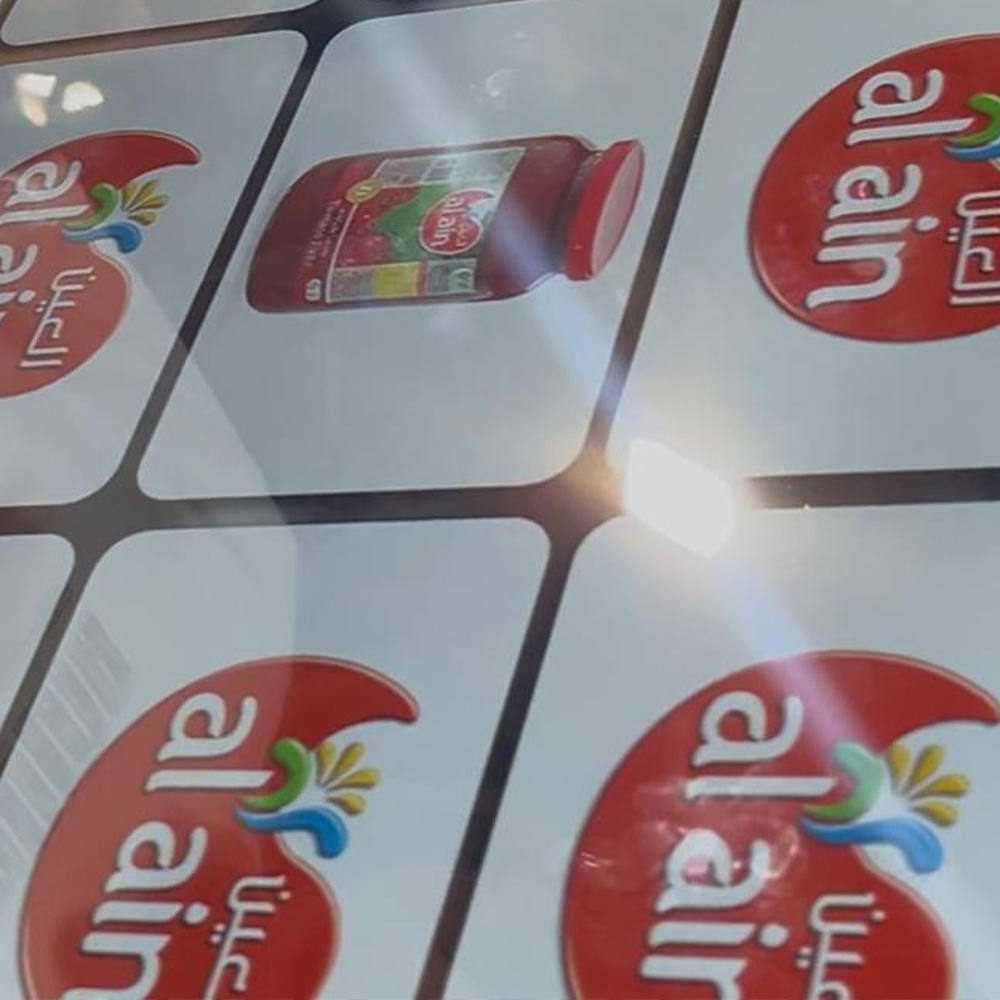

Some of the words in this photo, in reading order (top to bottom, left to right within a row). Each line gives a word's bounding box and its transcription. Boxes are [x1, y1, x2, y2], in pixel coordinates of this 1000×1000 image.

[848, 68, 974, 146] al
[429, 217, 457, 247] ain
[441, 197, 466, 215] al
[806, 163, 940, 309] ain
[20, 265, 97, 368] العين
[144, 691, 274, 793] al
[685, 690, 839, 800] al
[201, 875, 292, 1000] عين
